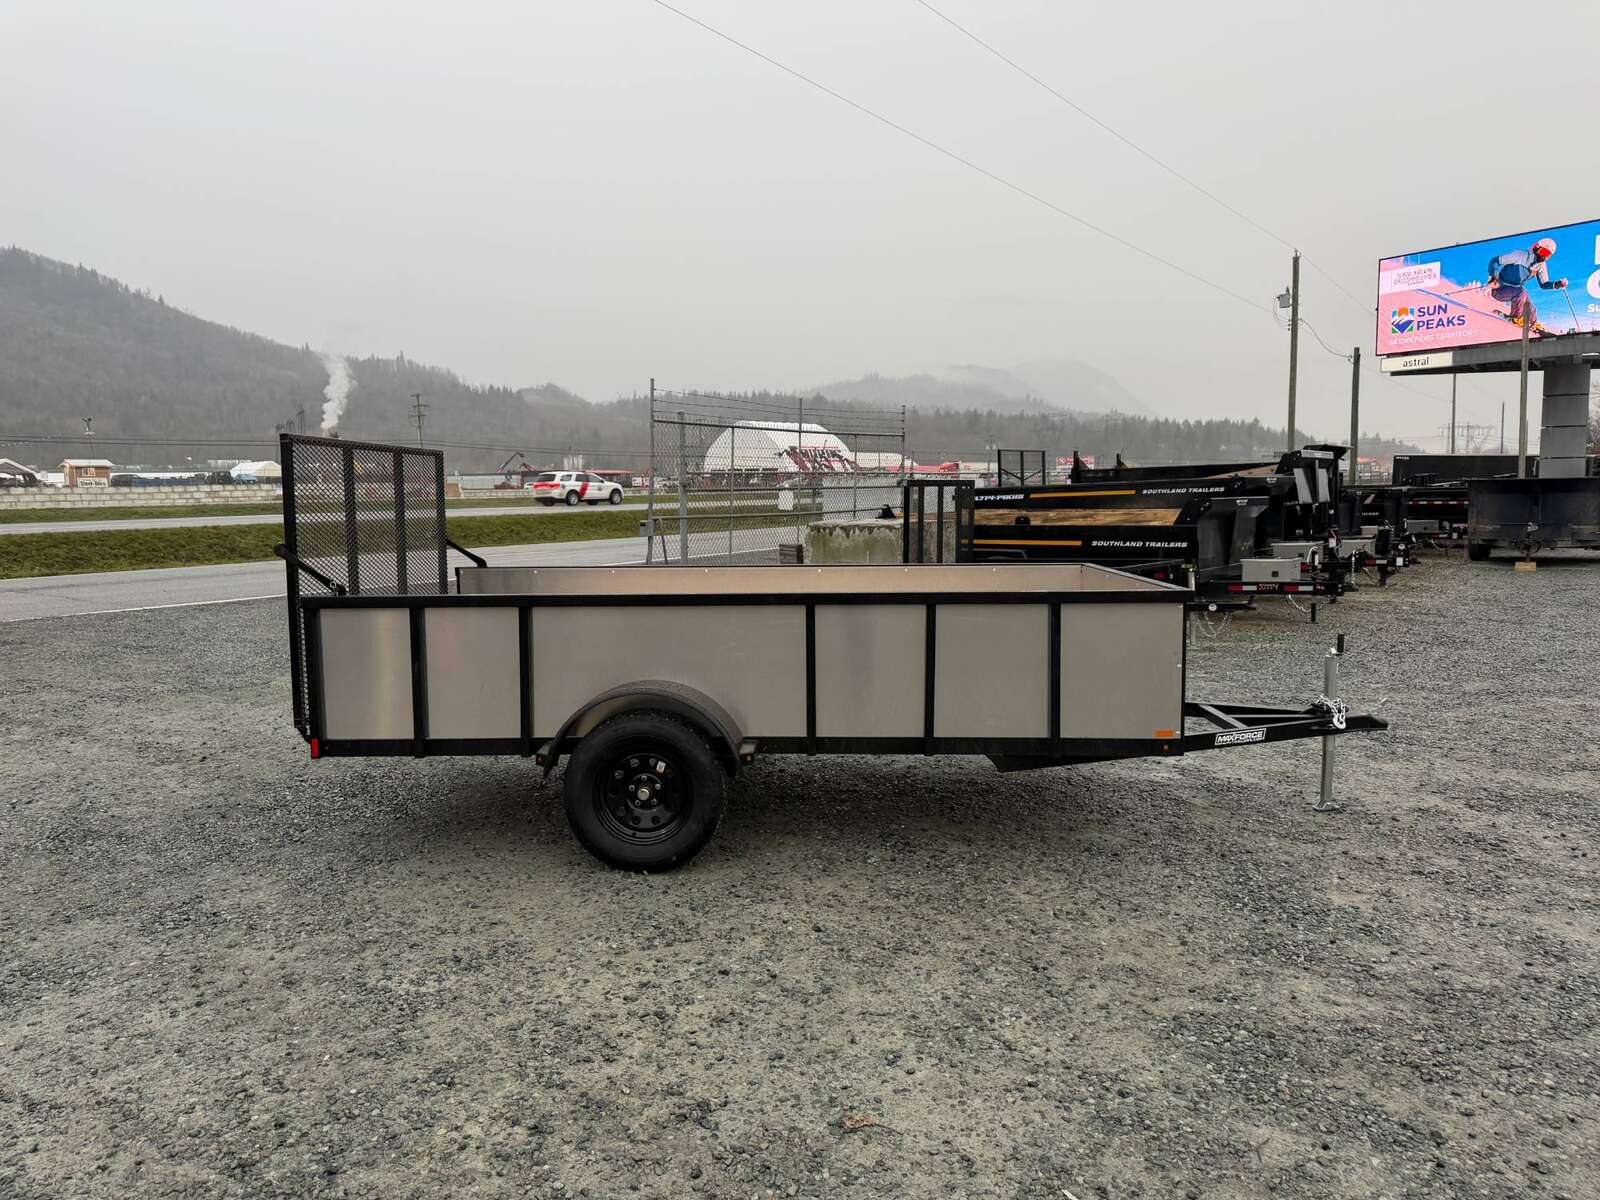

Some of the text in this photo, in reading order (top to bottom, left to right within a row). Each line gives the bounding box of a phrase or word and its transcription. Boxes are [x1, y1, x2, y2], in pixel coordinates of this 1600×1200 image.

[1417, 304, 1448, 318] SUN
[1416, 315, 1466, 331] PEAKS
[1402, 357, 1430, 368] astral
[1217, 730, 1264, 743] MAXFORCE
